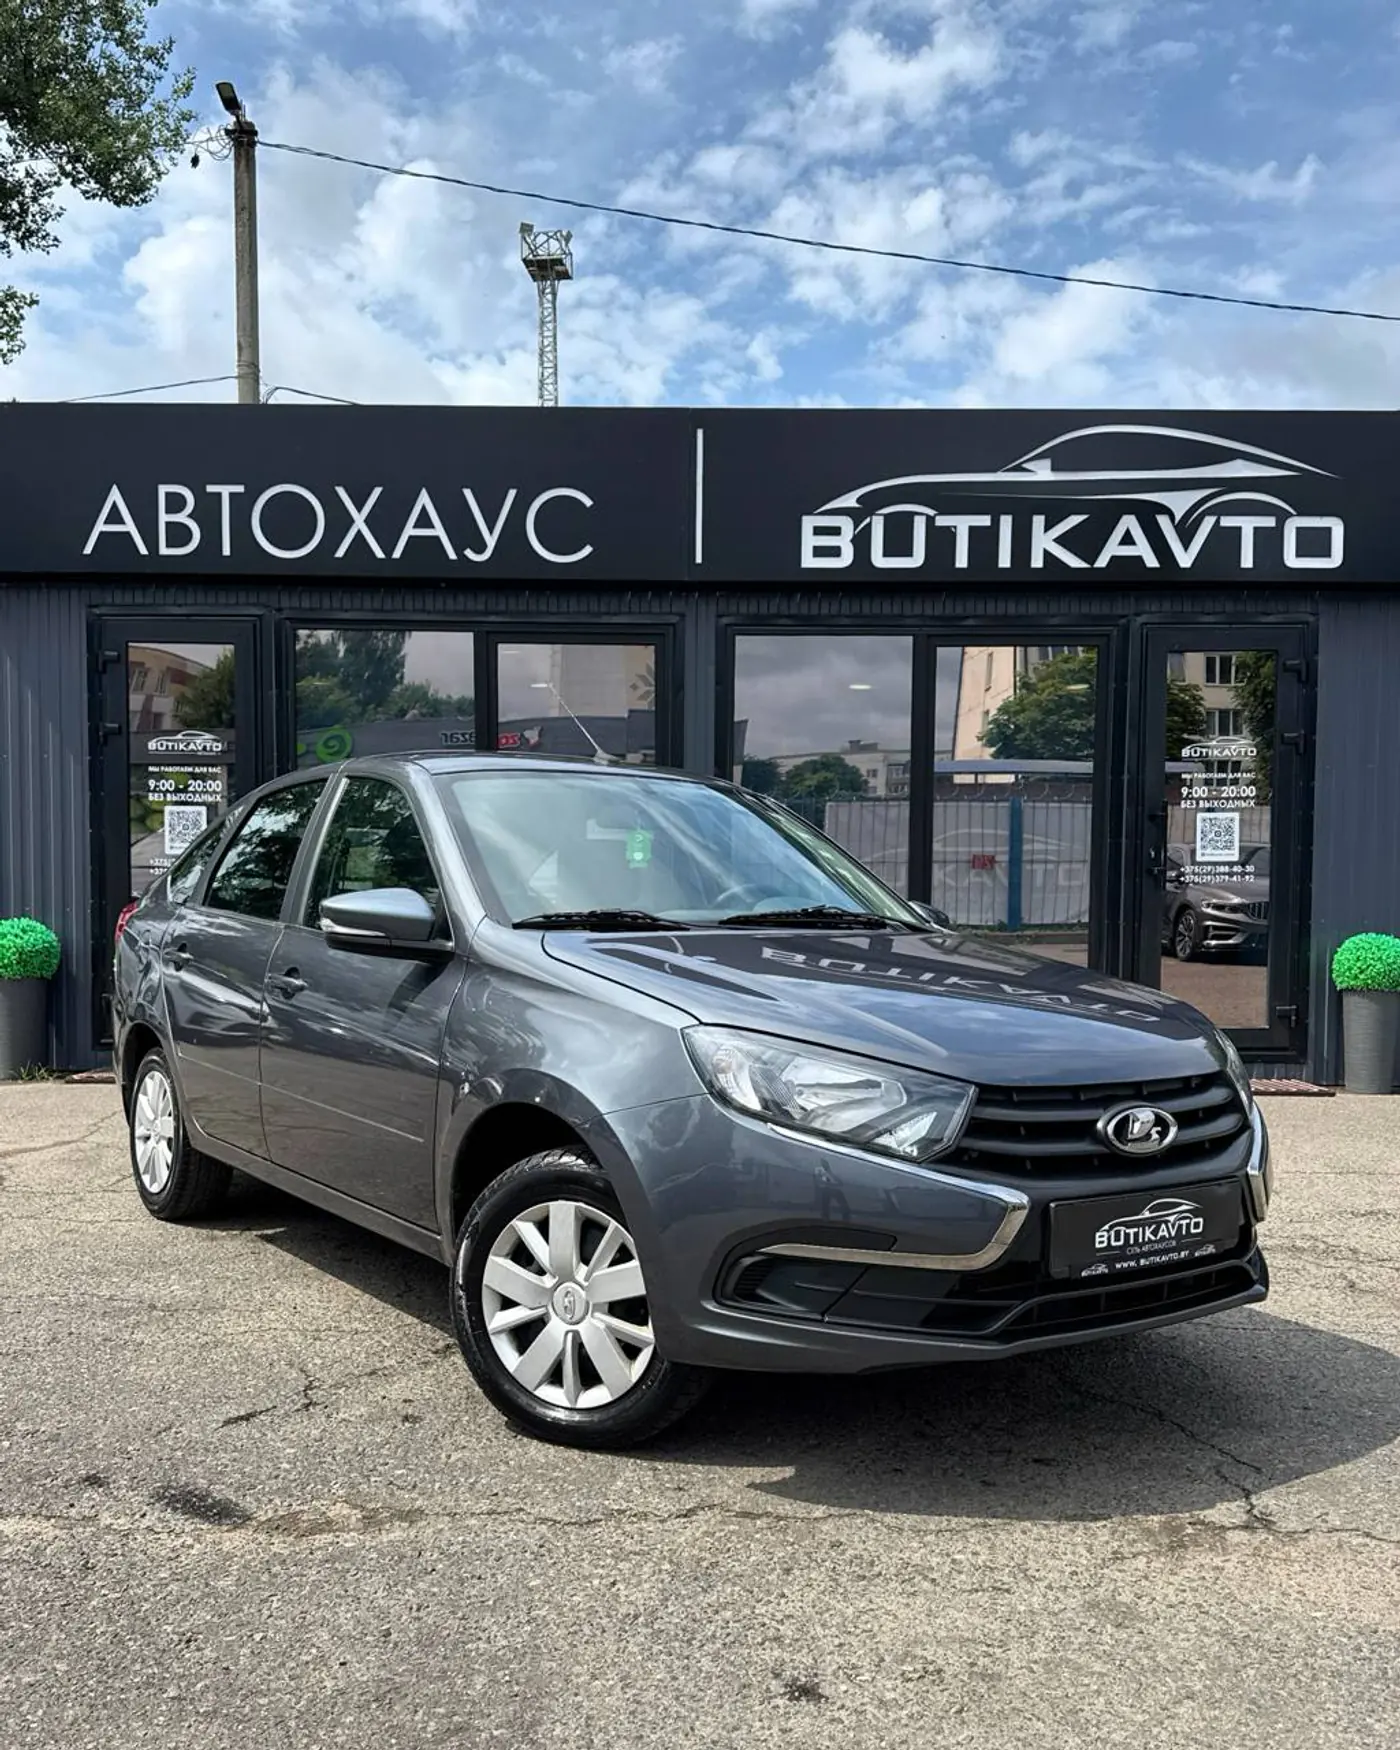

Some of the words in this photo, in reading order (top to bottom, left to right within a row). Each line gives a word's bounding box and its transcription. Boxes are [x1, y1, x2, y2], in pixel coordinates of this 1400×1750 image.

[82, 483, 595, 563] АВТОХАУС
[800, 514, 1344, 569] BUTIKAVTO
[147, 740, 222, 751] BUTIKAVTO
[1181, 747, 1257, 757] BUTIKAVTO
[148, 779, 175, 791] 9:00
[187, 779, 222, 792] 20:00
[148, 793, 164, 801] БЕЗ
[166, 793, 222, 802] ВЫХОДНЫХ
[1181, 786, 1208, 798] 9:00
[1220, 786, 1256, 797] 20:00
[1181, 800, 1196, 809] БЕЗ
[1199, 800, 1256, 809] ВЫХОДНЫХ
[1094, 1217, 1204, 1248] BUTIKAVTO
